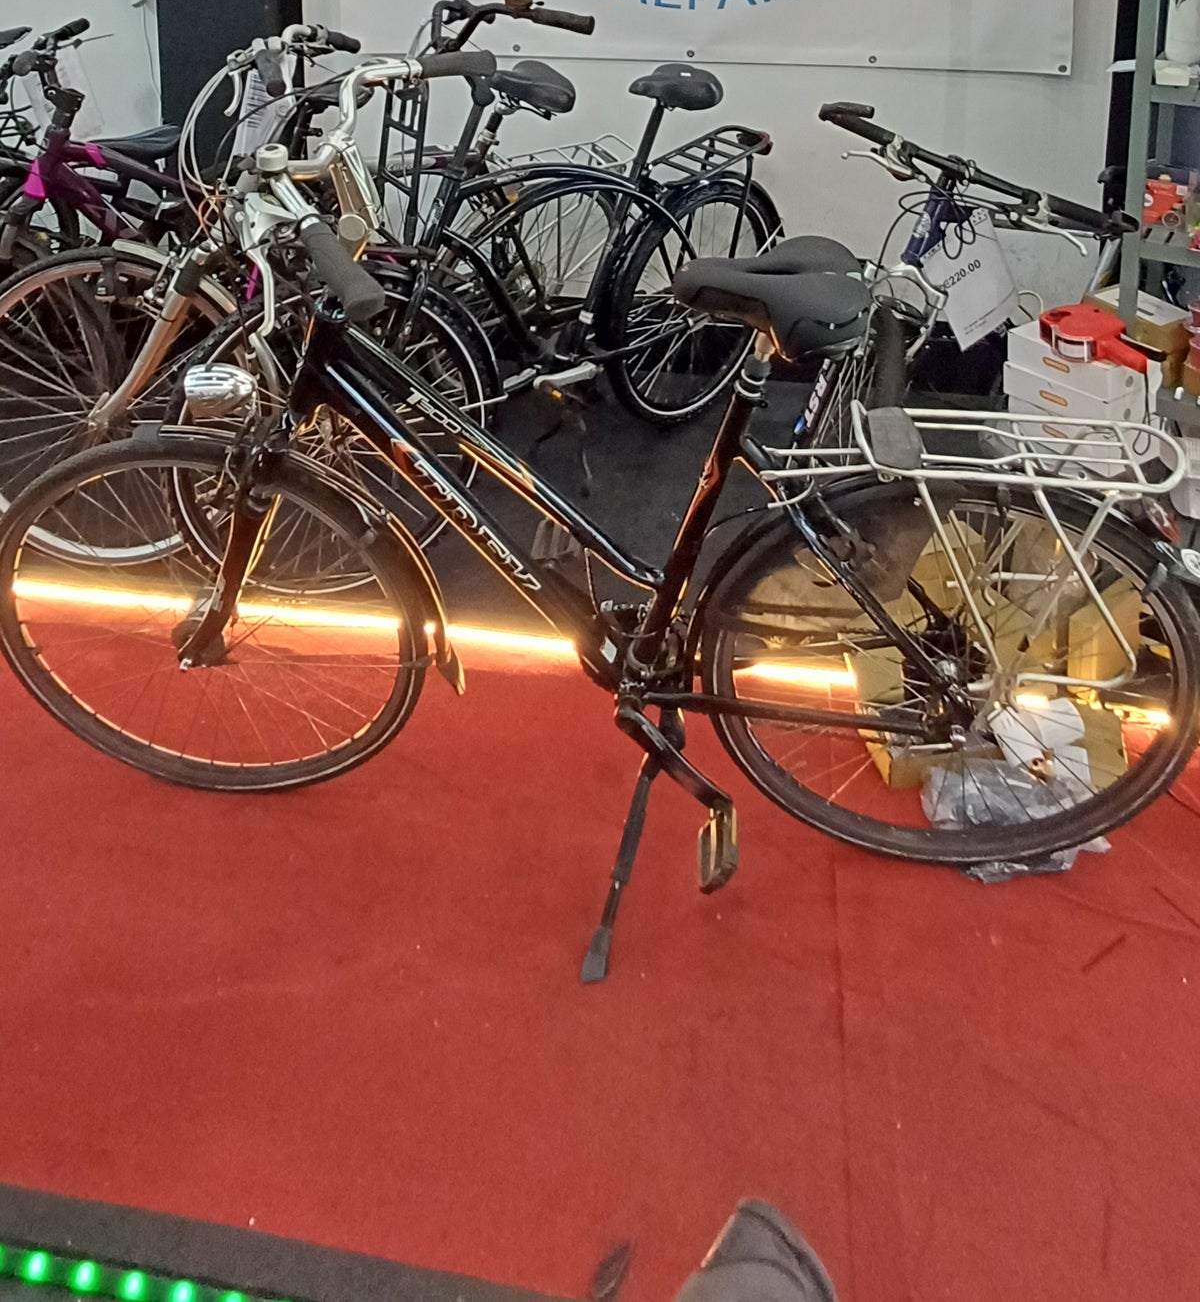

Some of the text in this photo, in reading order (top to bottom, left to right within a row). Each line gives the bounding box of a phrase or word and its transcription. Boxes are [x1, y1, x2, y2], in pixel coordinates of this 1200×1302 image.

[943, 259, 982, 290] €220.00
[407, 386, 462, 434] T300
[803, 372, 829, 429] RST
